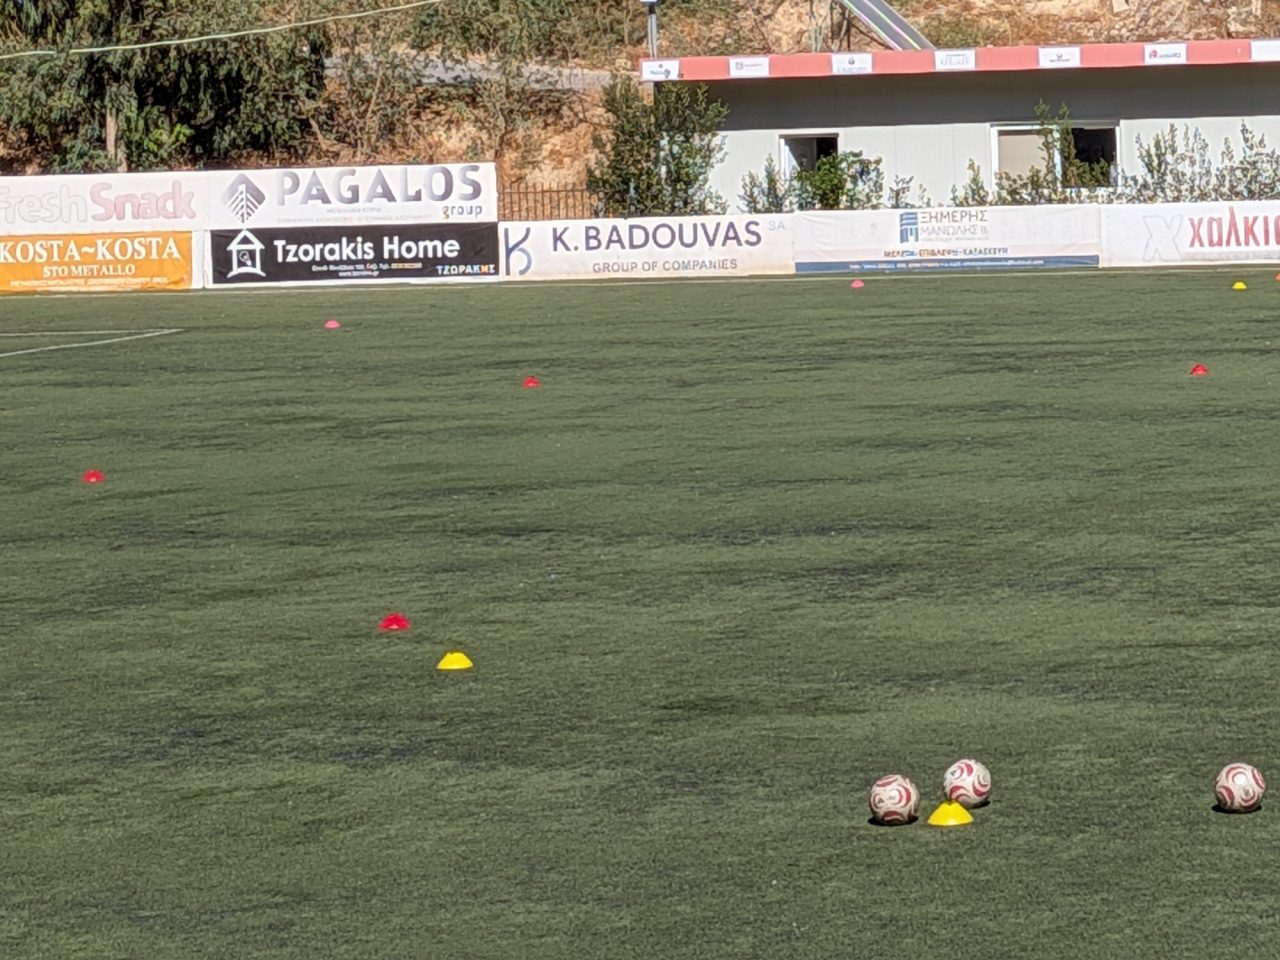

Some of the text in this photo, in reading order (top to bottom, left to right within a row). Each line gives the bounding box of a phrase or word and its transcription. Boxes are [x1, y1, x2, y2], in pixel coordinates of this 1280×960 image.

[276, 165, 482, 206] PAGALOS
[442, 205, 483, 219] group
[920, 209, 988, 224] ΞΗΜΕΡΗΣ
[273, 236, 460, 263] Tzorakis Home
[43, 264, 136, 278] STO METALLO
[592, 259, 738, 274] GROUP OF COMPANIES
